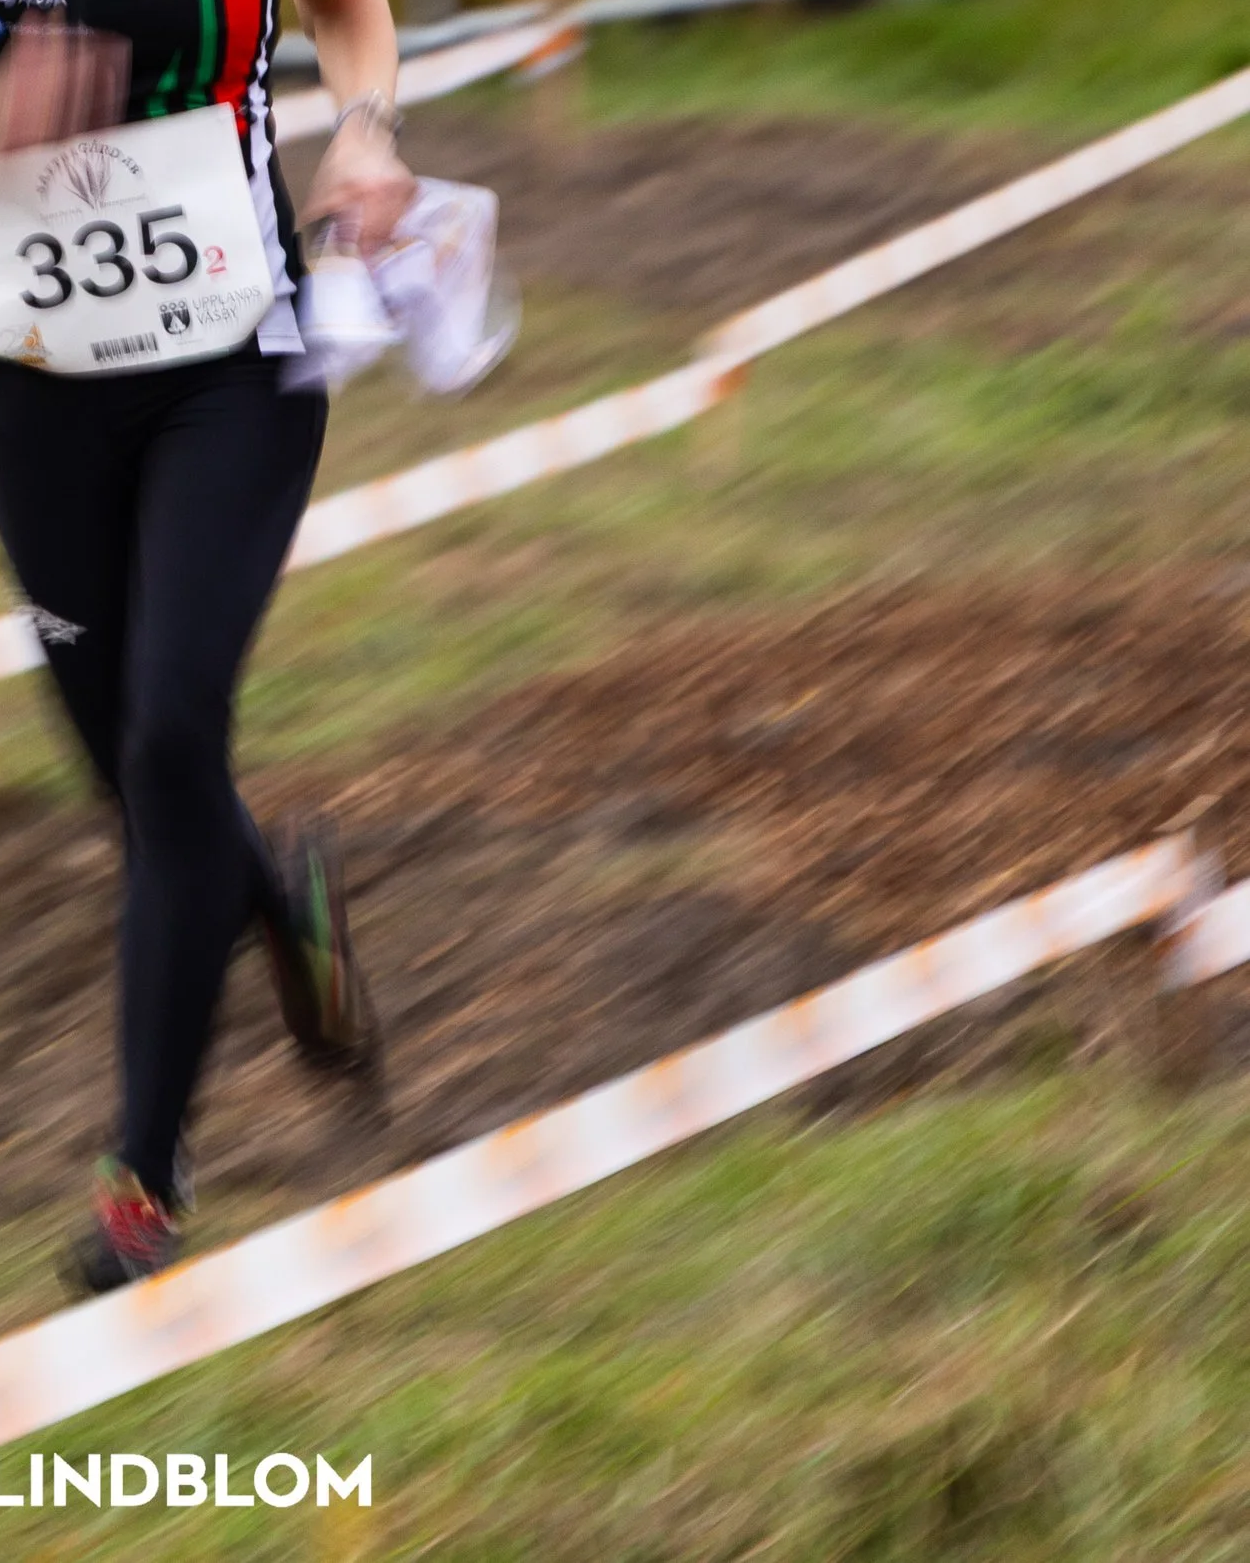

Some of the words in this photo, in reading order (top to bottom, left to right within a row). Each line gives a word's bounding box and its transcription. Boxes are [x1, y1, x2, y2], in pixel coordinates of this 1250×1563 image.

[15, 203, 198, 310] 335
[203, 245, 227, 274] 2
[192, 285, 261, 310] UPPLANDS
